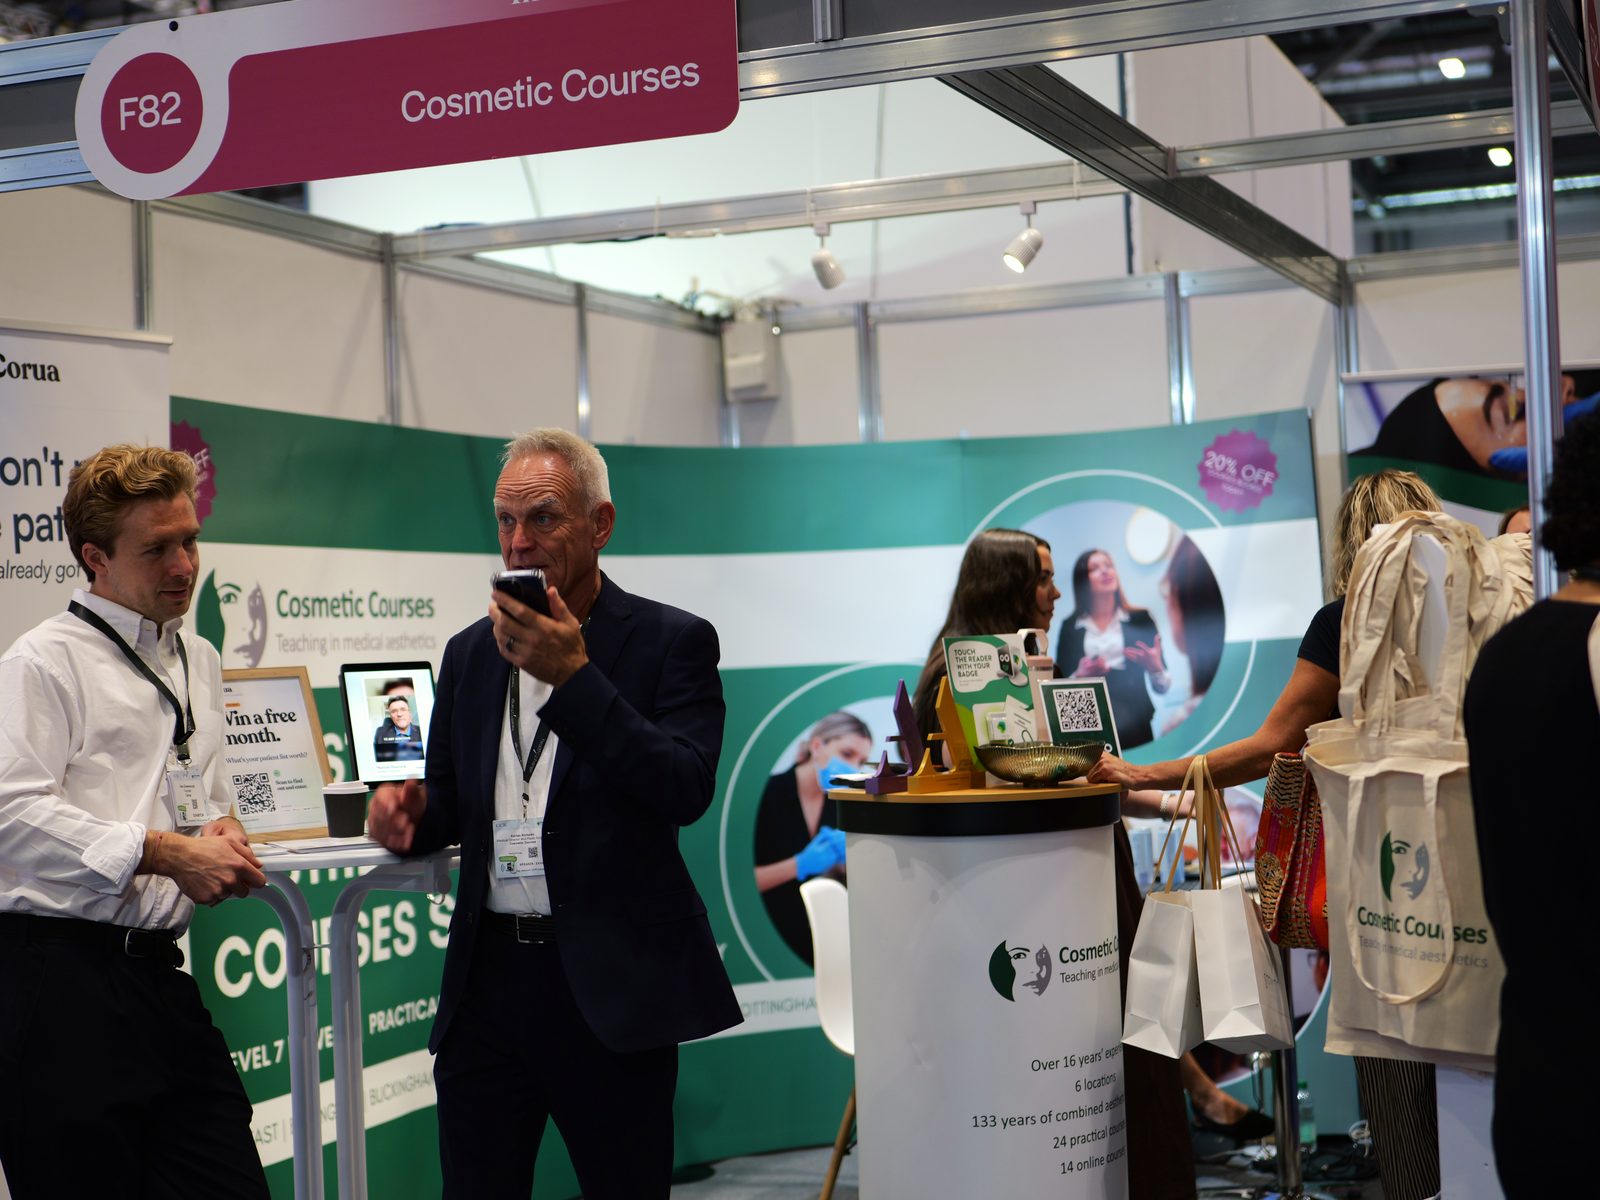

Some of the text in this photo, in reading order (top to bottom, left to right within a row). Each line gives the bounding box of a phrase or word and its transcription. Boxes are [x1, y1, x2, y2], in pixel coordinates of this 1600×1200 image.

[400, 60, 700, 124] Cosmetic Courses
[118, 90, 182, 131] F82
[0, 446, 64, 487] on't
[1204, 450, 1237, 477] 20%
[1241, 463, 1275, 487] OFF
[13, 506, 64, 554] pat
[276, 589, 435, 618] Cosmetic Courses
[276, 631, 437, 656] Teaching in medical aesthetics
[958, 670, 978, 678] BADGE
[253, 713, 264, 724] a
[265, 708, 297, 724] free
[1059, 937, 1113, 964] Cosmetic
[1420, 950, 1488, 969] aestetics
[1060, 968, 1096, 983] Teaching
[1097, 966, 1104, 977] in
[369, 996, 438, 1034] PRACTICA
[740, 997, 816, 1017] OTTINGHA
[230, 1039, 285, 1073] EVEL 7
[1031, 1057, 1060, 1072] Over
[1063, 1054, 1076, 1068] 16
[1078, 1048, 1104, 1068] years'
[369, 1070, 434, 1106] BUCKINGHA
[1075, 1073, 1117, 1093] 6 locations
[972, 1115, 997, 1128] 133
[1001, 1113, 1036, 1130] years
[1040, 1110, 1053, 1124] of
[1055, 1101, 1104, 1122] combined
[1053, 1135, 1067, 1149] 24
[1070, 1125, 1108, 1149] practical
[1061, 1160, 1074, 1175] 14
[1076, 1155, 1105, 1172] online
